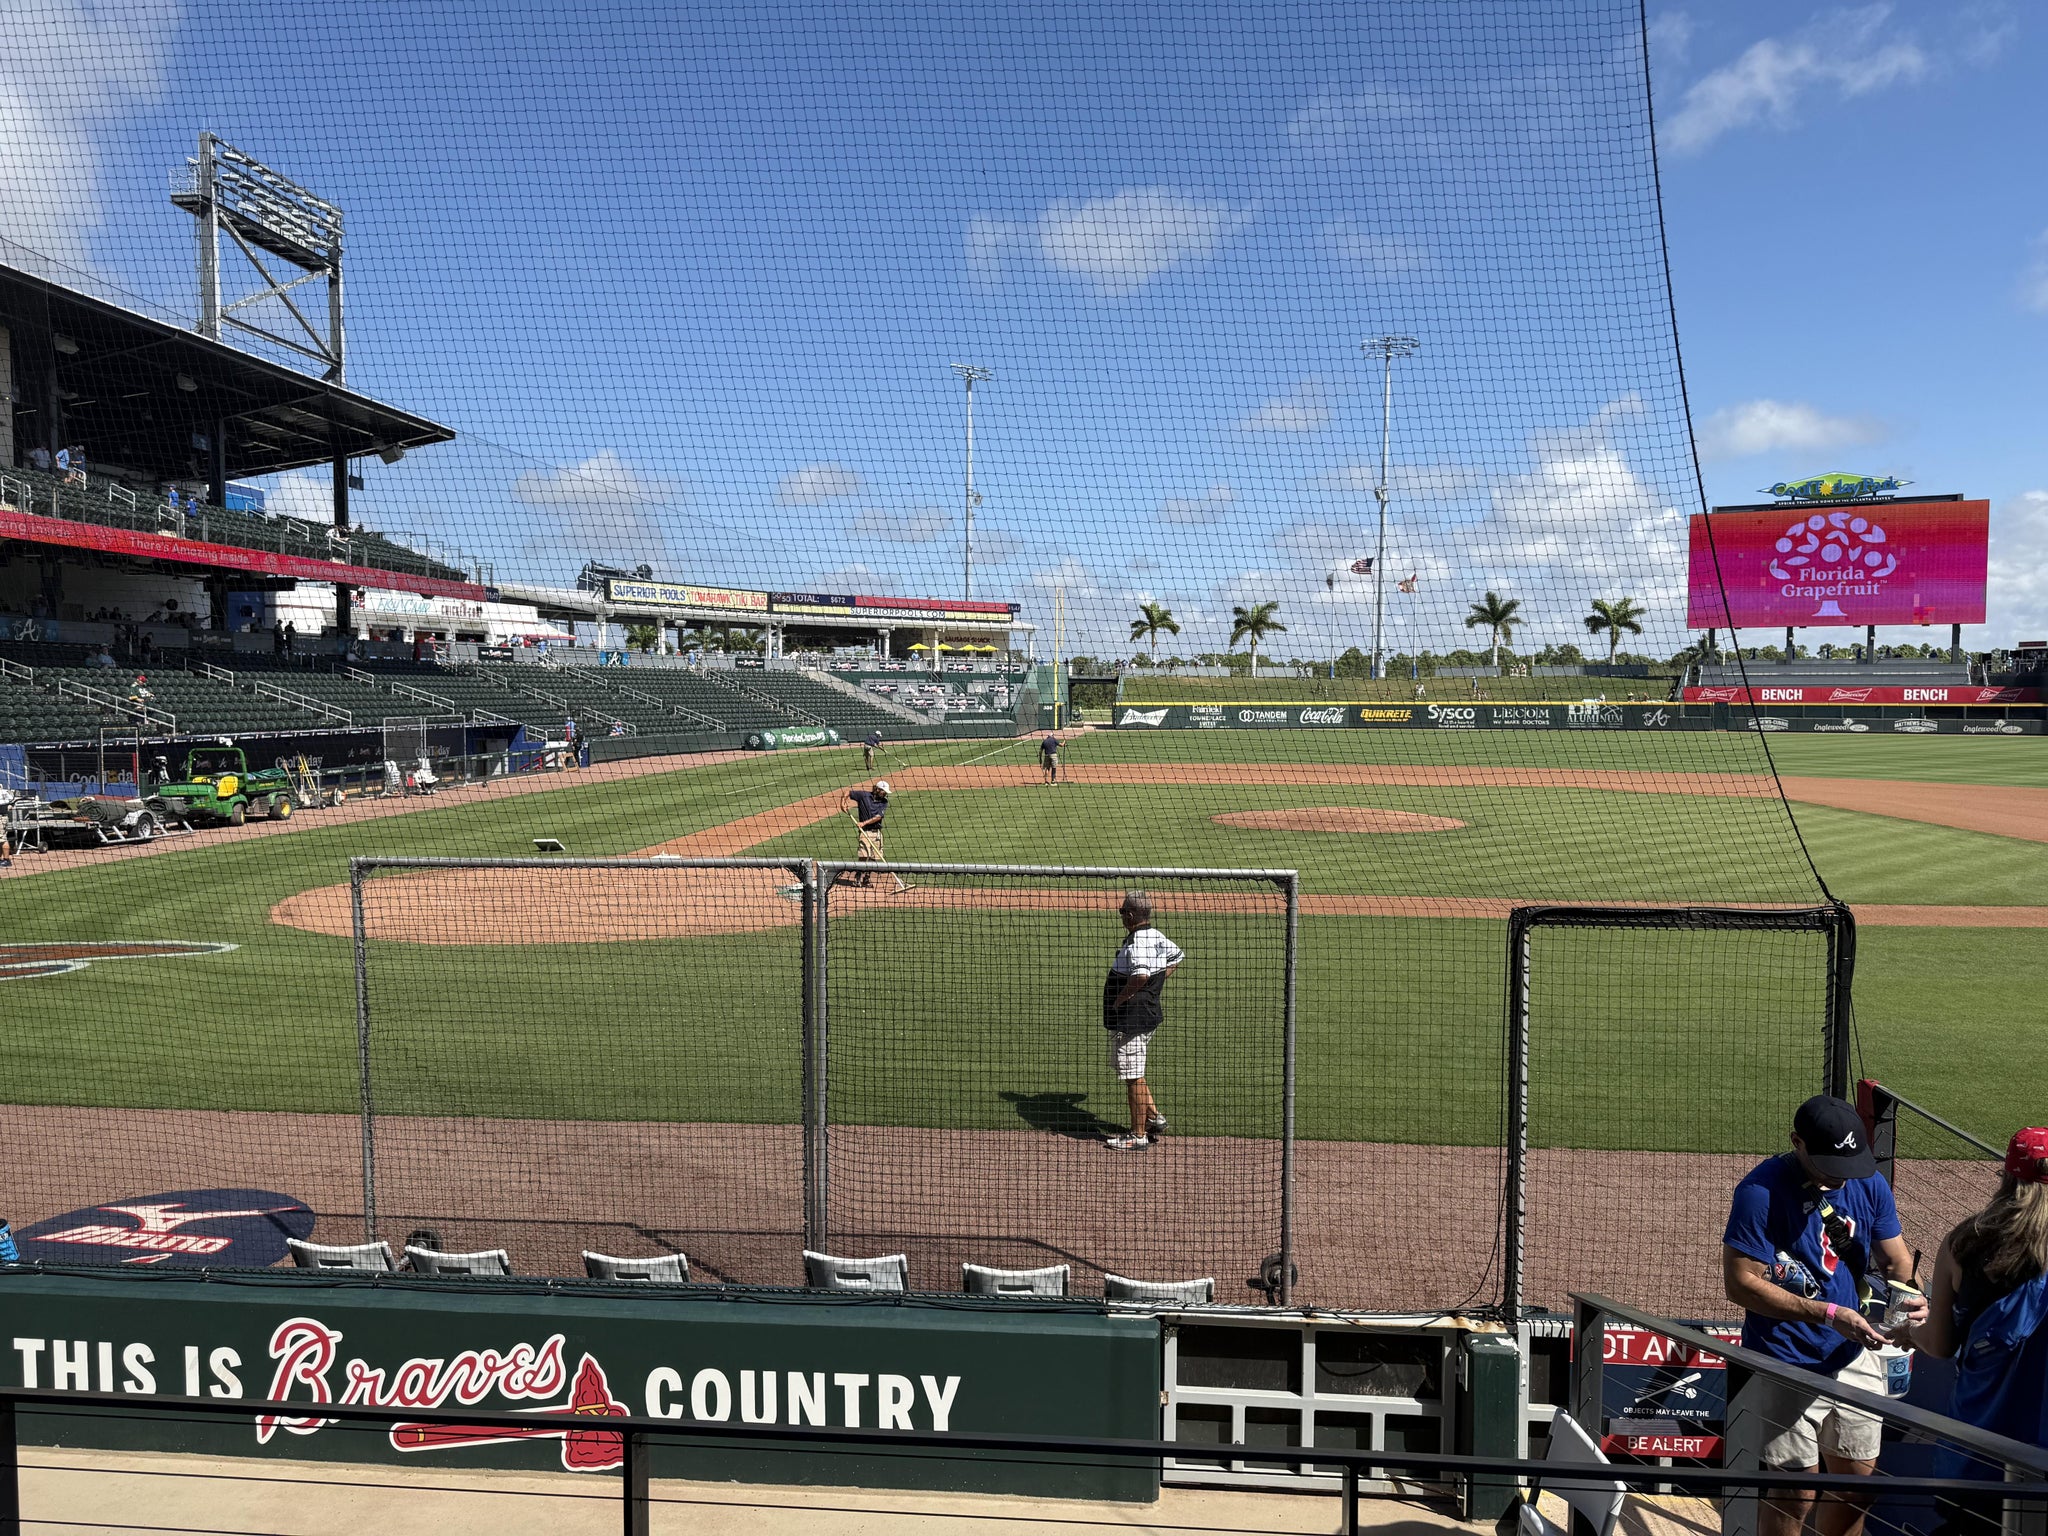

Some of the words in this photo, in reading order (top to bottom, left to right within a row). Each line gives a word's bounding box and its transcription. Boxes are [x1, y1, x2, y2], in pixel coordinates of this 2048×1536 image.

[1862, 476, 1899, 492] Park
[172, 543, 218, 561] Amazing
[1799, 566, 1865, 581] Florida
[613, 584, 657, 599] SUPERIOR
[660, 588, 686, 601] POOLS
[690, 590, 732, 604] TOMAHAWK
[734, 593, 748, 606] TIKI
[750, 595, 767, 607] BAR
[793, 593, 820, 603] TOTAL:
[1761, 688, 1803, 701] BENCH
[1903, 688, 1948, 701] BENCH
[1255, 711, 1287, 719] TANDEM
[1300, 707, 1346, 724] Coca-Cola
[1360, 708, 1413, 719] QUIKRETE
[1567, 714, 1623, 723] ALUMINUM
[1814, 723, 1847, 731] Englewood
[1963, 725, 2000, 733] Englewood
[1603, 1334, 1636, 1361] OT
[1643, 1336, 1687, 1362] AN
[14, 1337, 155, 1396] THIS
[184, 1345, 244, 1399] IS
[255, 1317, 567, 1444] Braves
[645, 1366, 961, 1432] COUNTRY
[1623, 1407, 1655, 1415] OBJECTS
[1655, 1408, 1671, 1416] MAY
[1672, 1409, 1695, 1417] LEAVE
[1627, 1436, 1649, 1451] BE
[1652, 1437, 1704, 1453] ALERT
